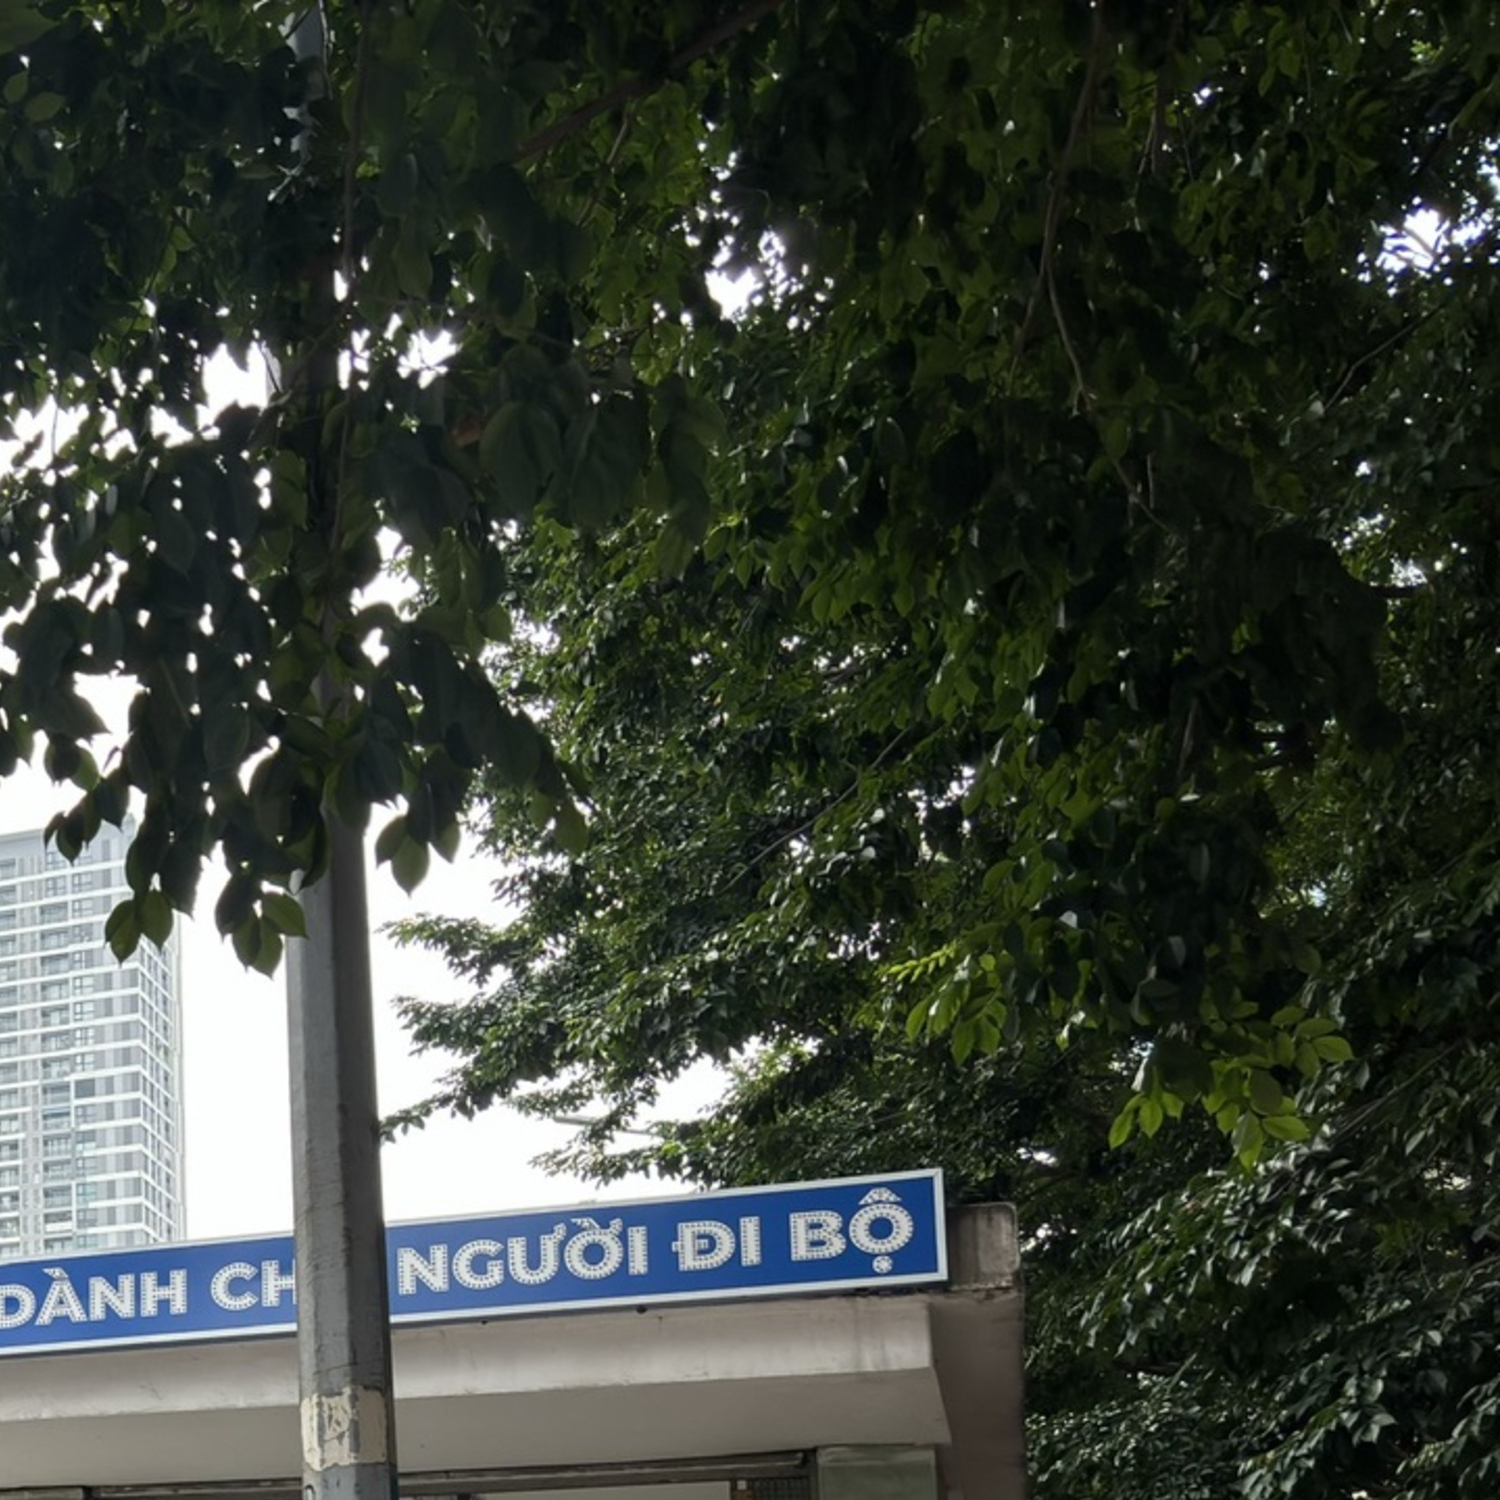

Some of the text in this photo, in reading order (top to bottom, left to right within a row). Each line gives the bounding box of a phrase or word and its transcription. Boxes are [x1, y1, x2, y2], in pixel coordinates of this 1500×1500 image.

[210, 1259, 297, 1312] CH
[397, 1217, 648, 1295] NGƯỜI
[671, 1216, 762, 1272] ĐI
[788, 1187, 914, 1275] BỘ
